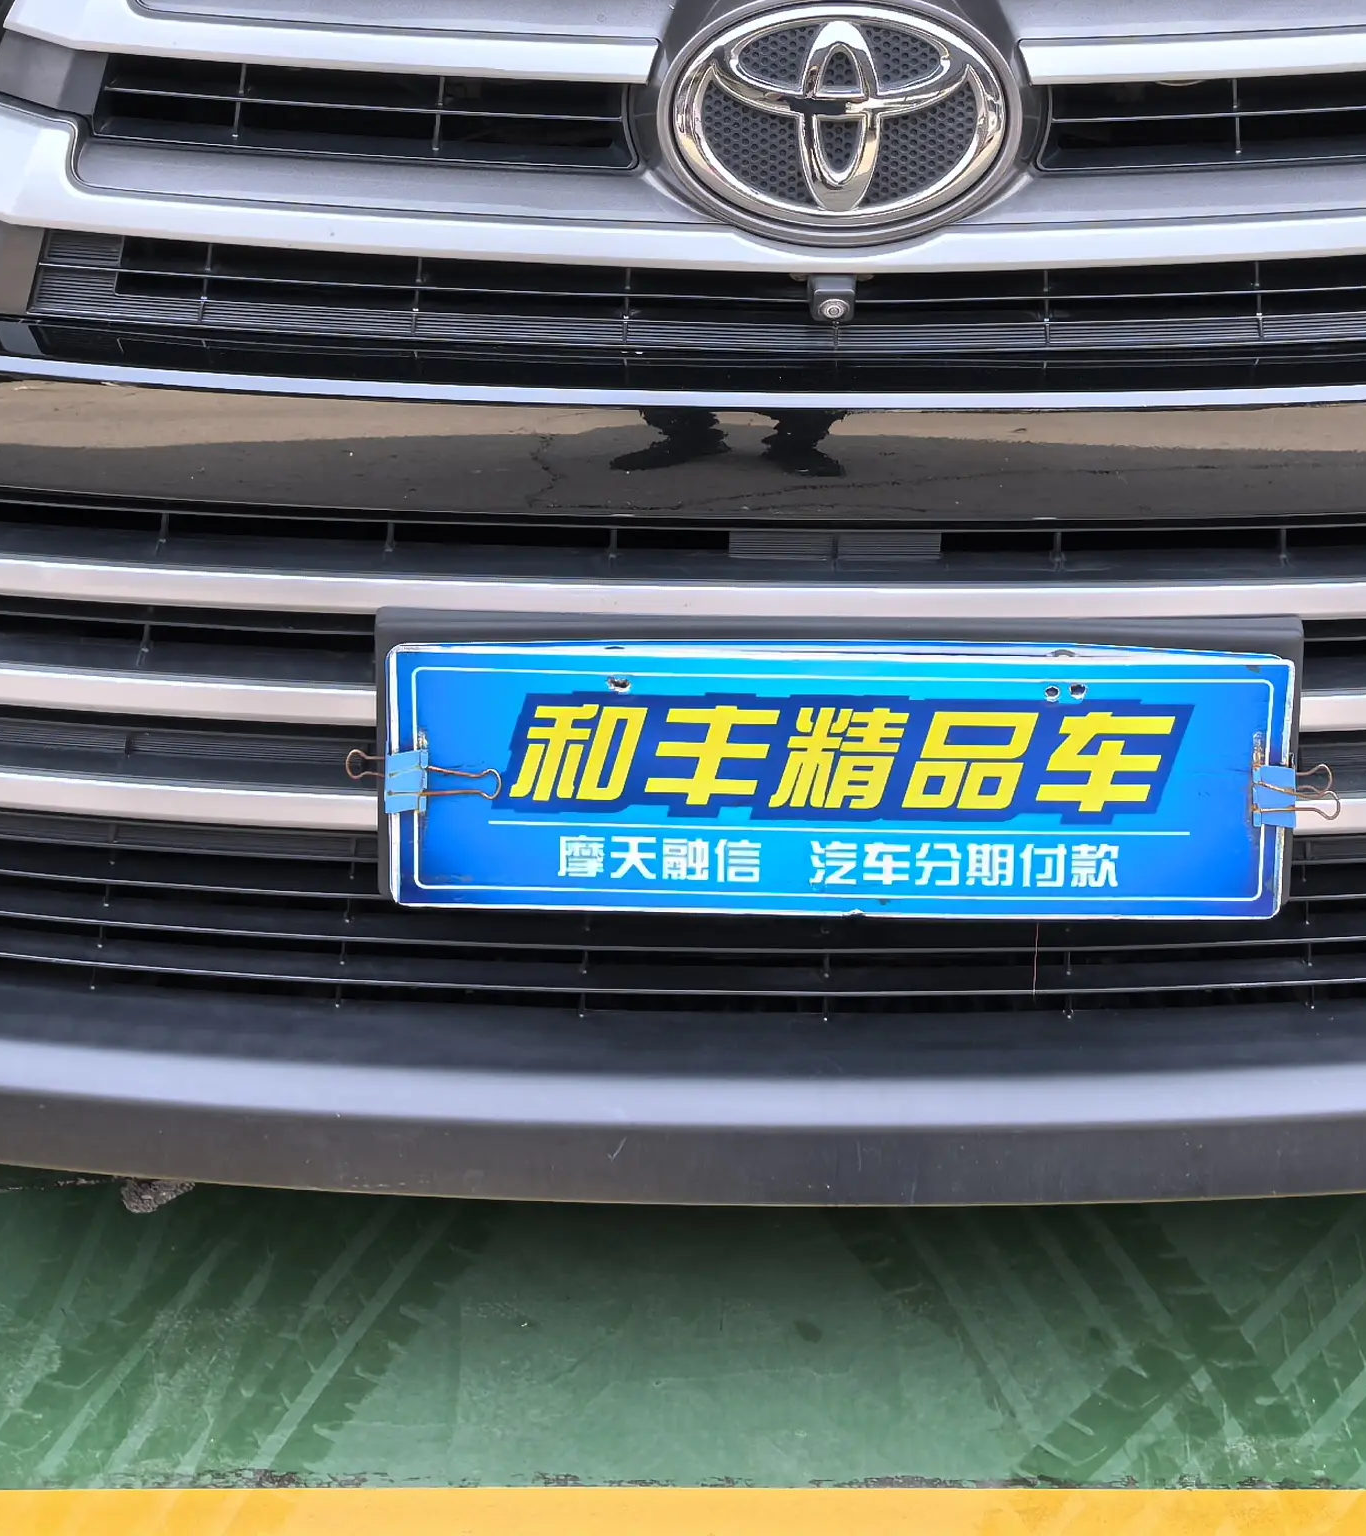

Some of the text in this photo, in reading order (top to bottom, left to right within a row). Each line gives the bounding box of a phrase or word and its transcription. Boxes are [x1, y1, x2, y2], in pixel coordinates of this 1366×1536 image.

[508, 702, 1177, 814] 和丰精品车
[556, 832, 1122, 889] 摩天融信 汽车分期付款
